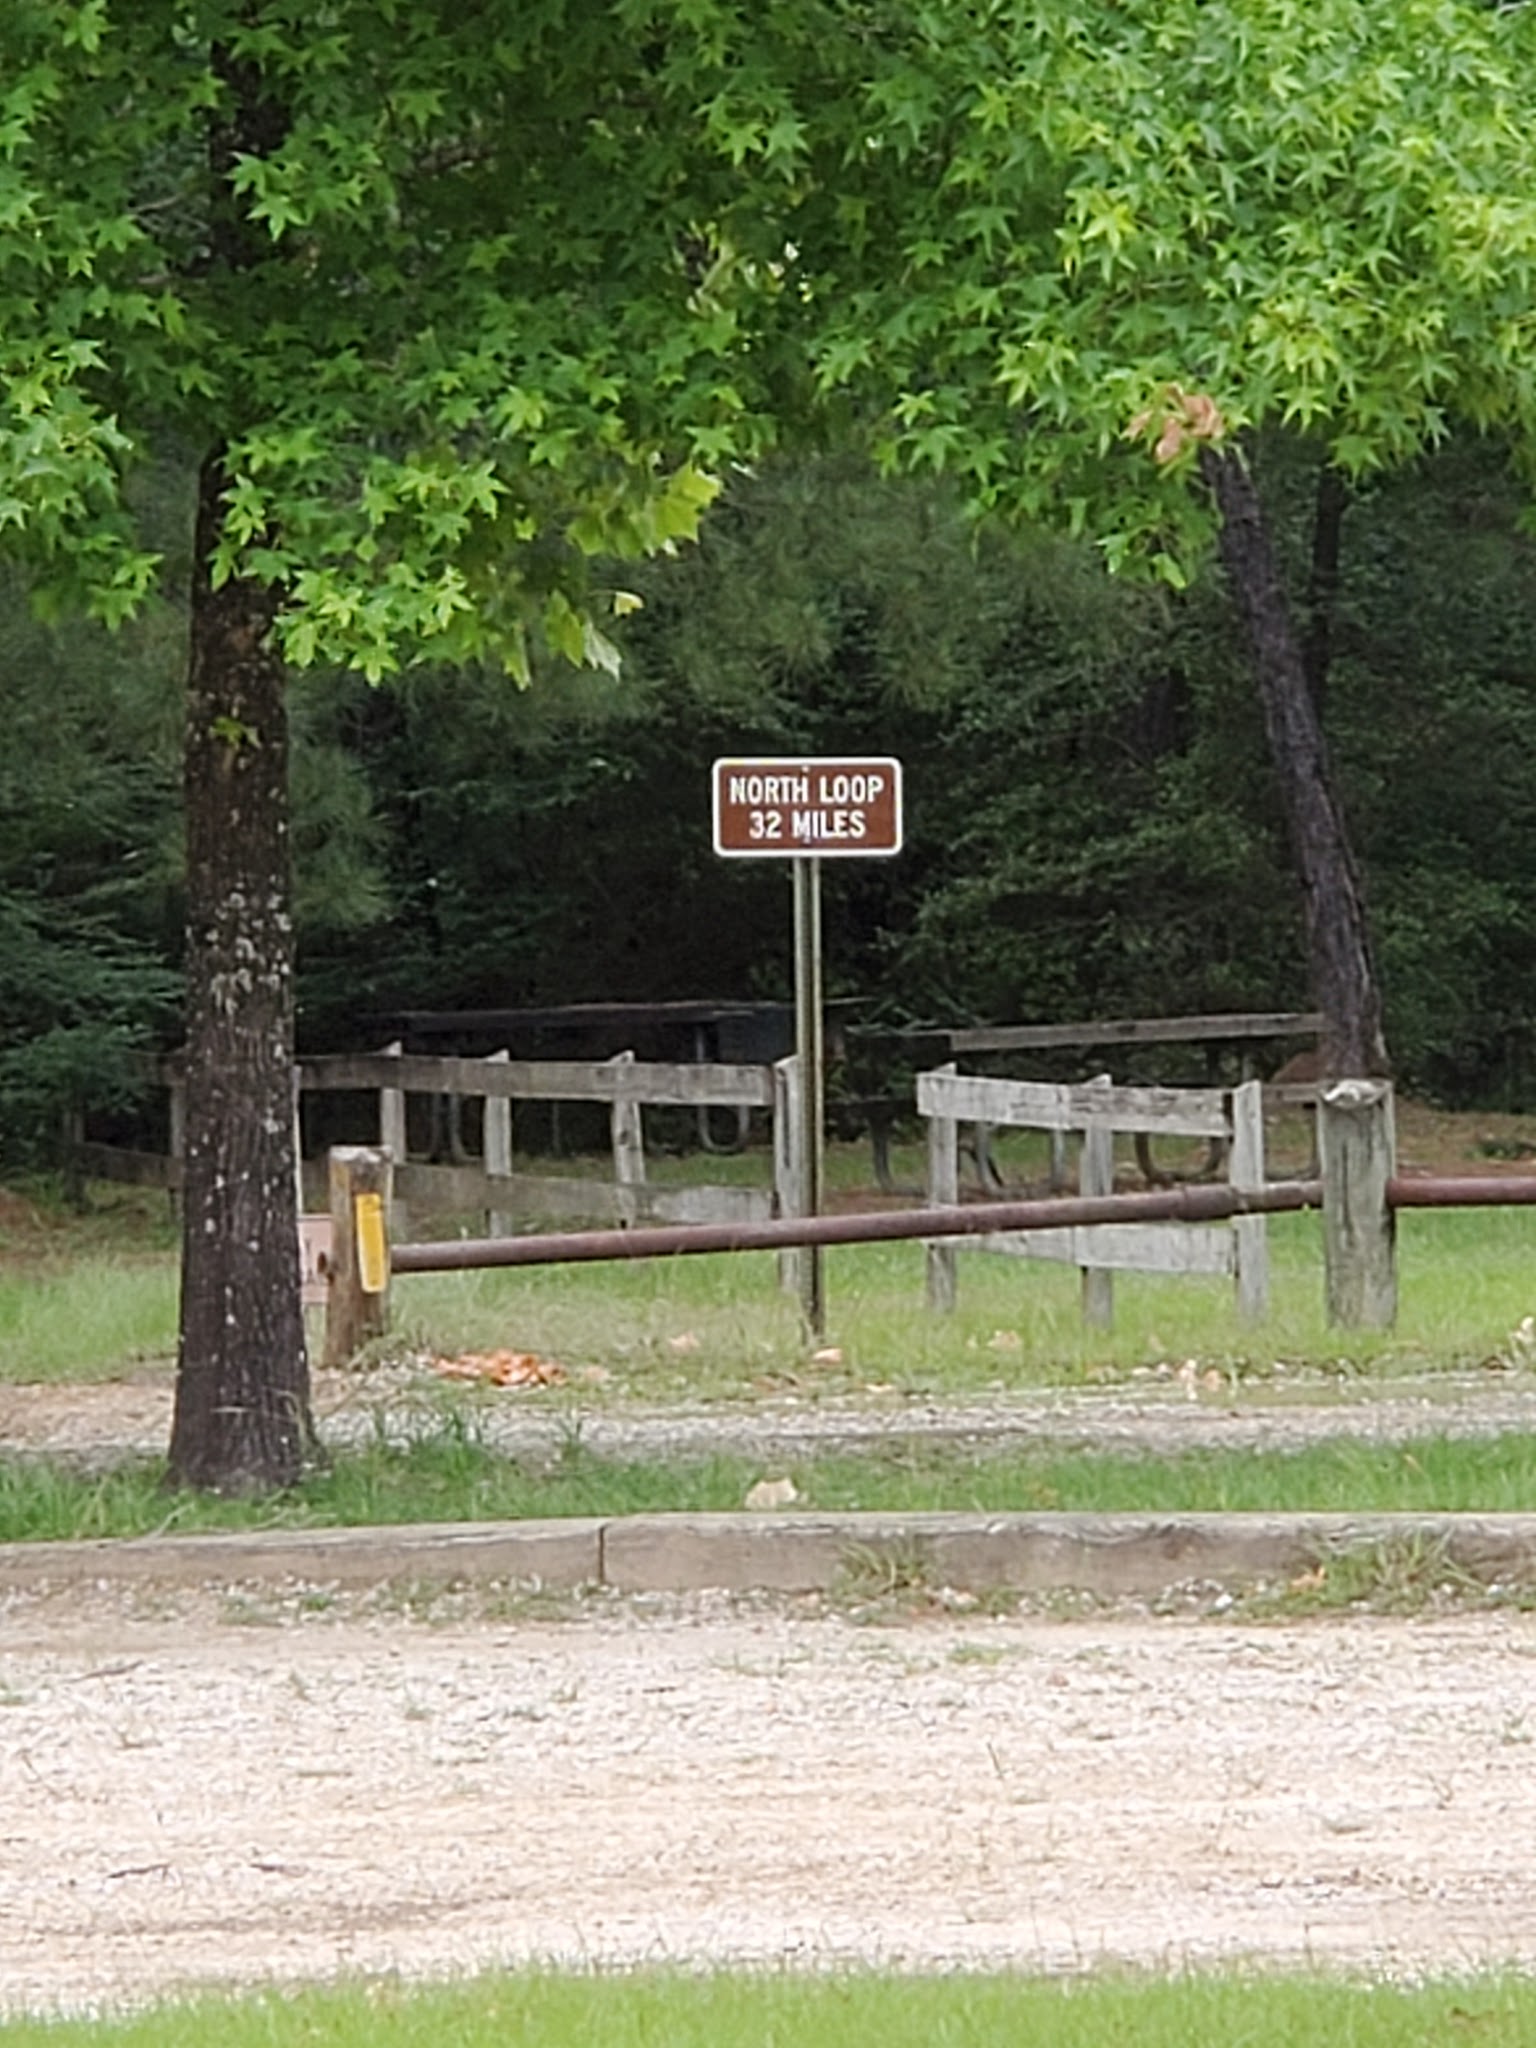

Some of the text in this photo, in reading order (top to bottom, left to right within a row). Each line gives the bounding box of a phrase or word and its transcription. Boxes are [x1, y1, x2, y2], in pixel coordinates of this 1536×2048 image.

[730, 775, 884, 804] NORTH LOOP
[749, 809, 866, 839] 32 MILES
